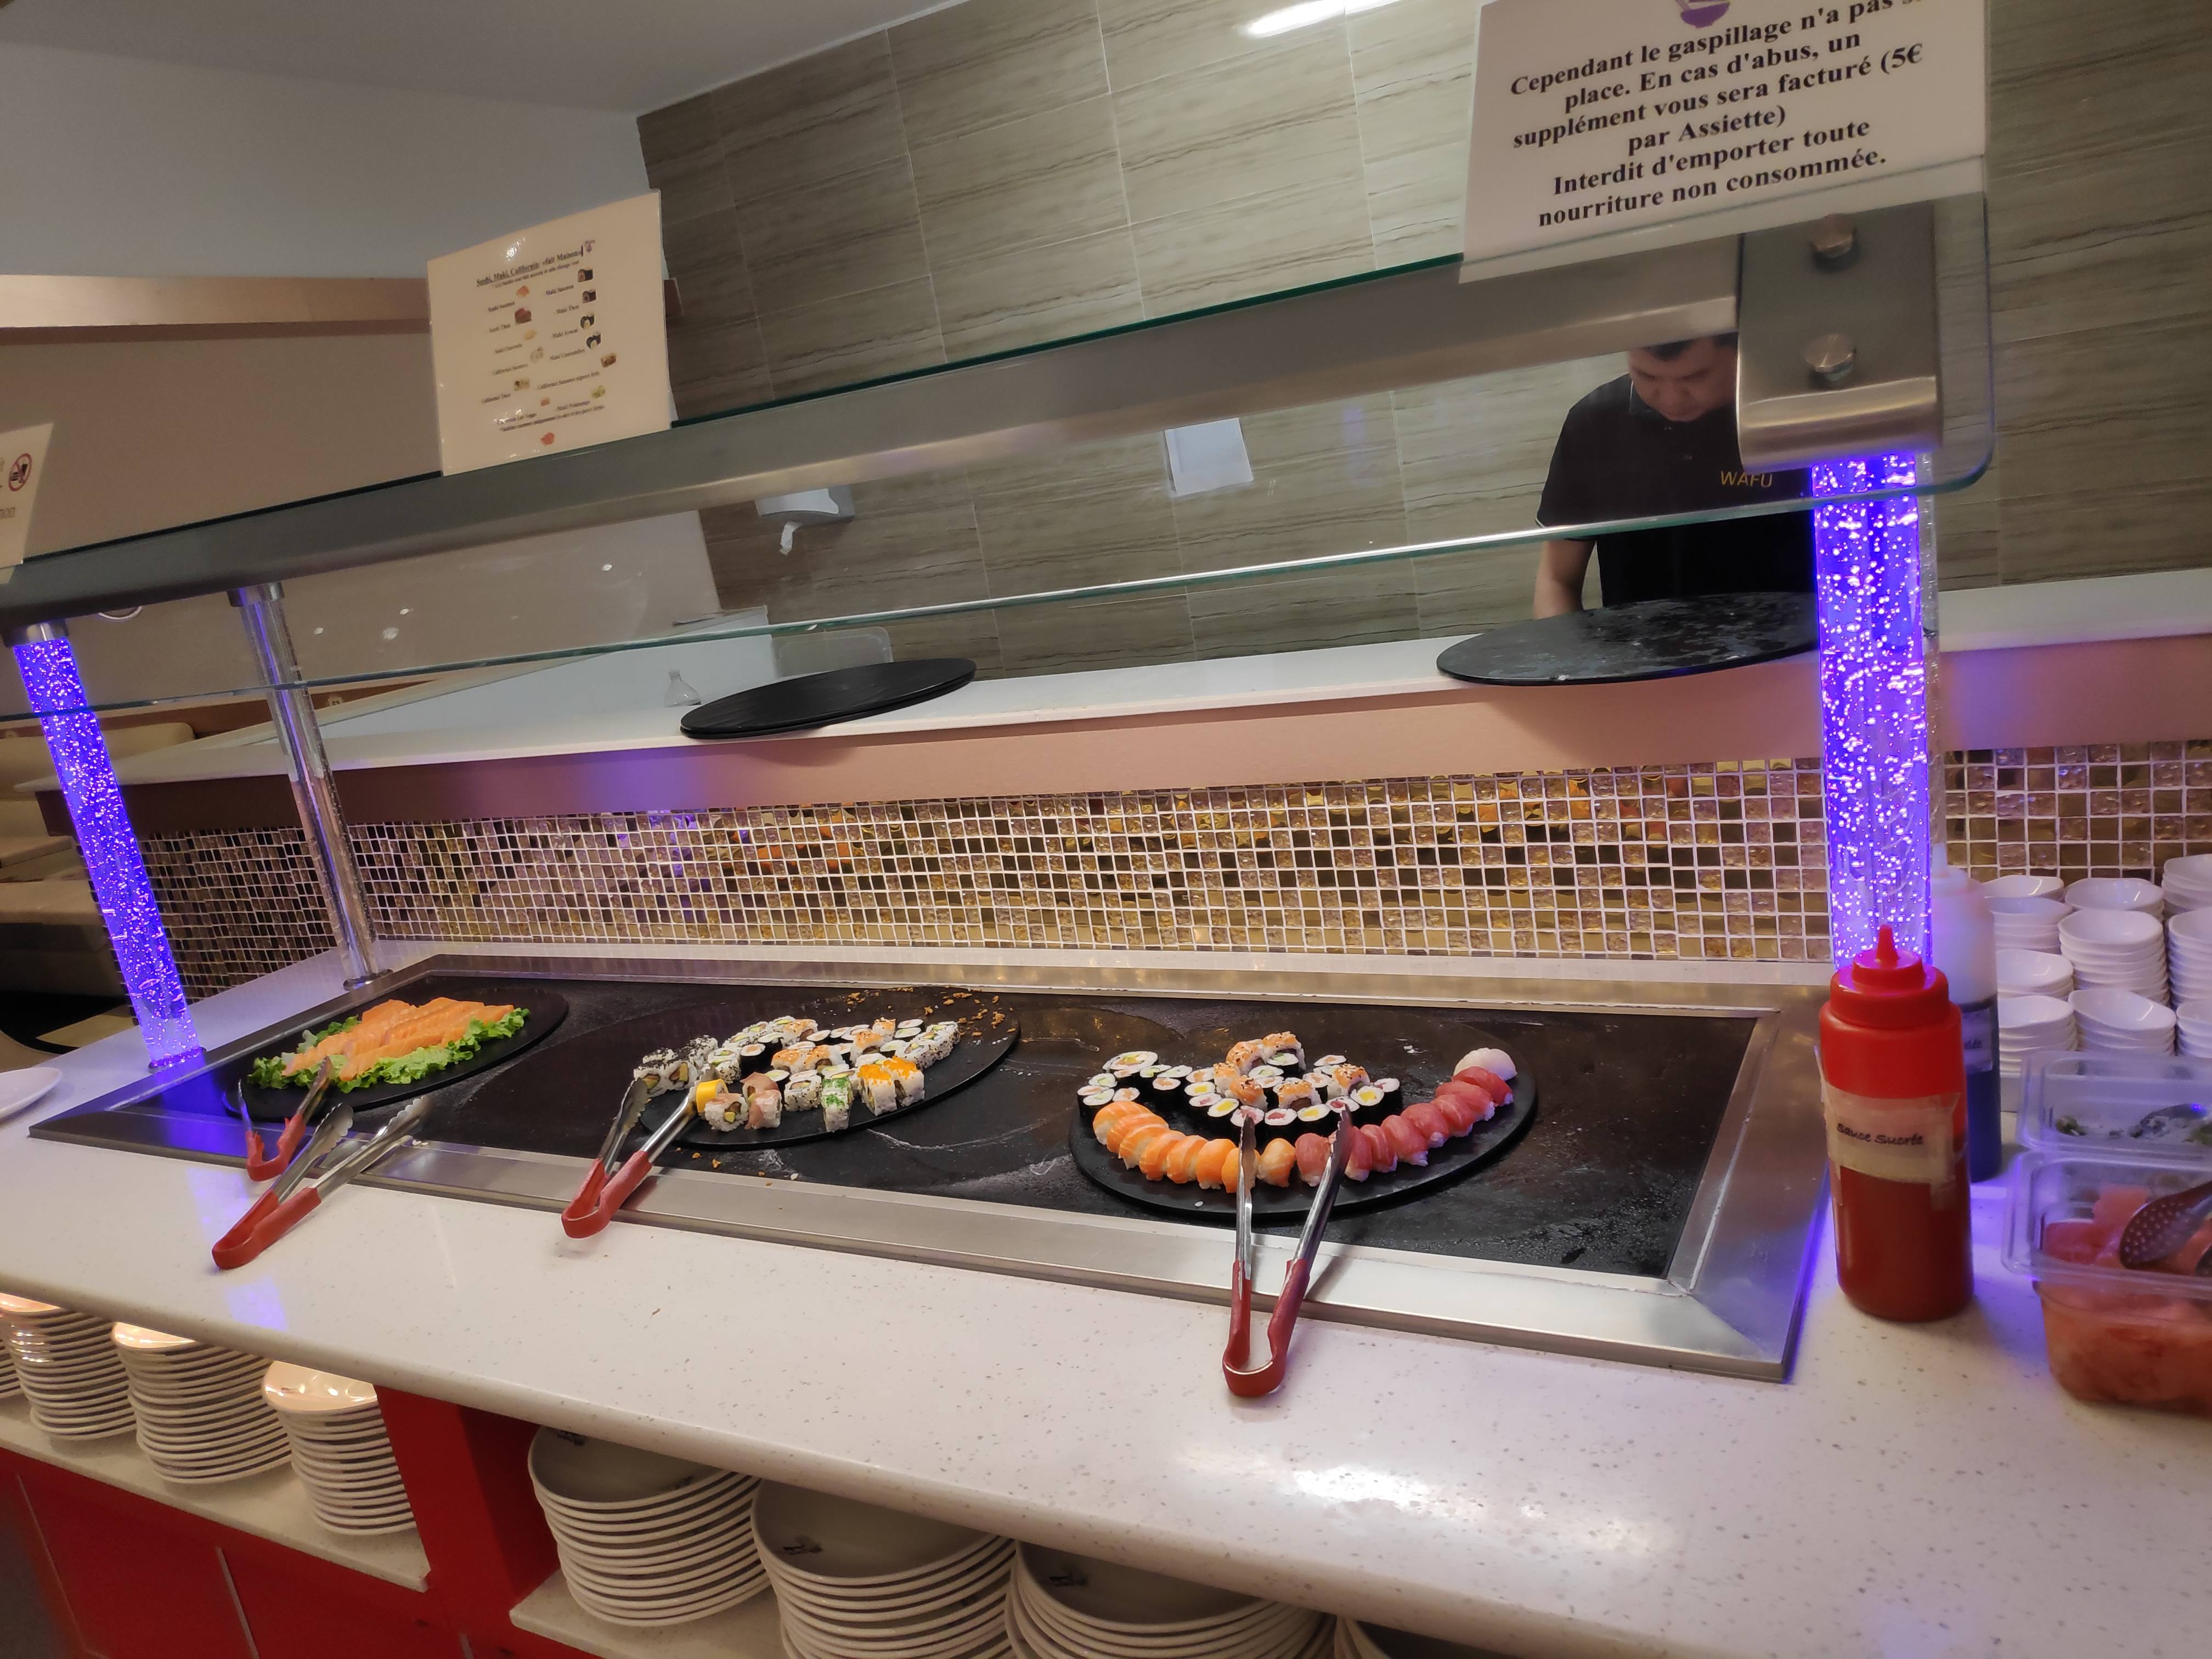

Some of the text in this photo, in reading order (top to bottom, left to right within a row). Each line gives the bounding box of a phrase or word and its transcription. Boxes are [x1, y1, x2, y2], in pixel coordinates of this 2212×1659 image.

[1510, 0, 1893, 95] Cependant le gaspillage n'a pas
[1565, 33, 1860, 114] place. En cas d'abus, un
[1513, 43, 1923, 148] supplément vous sera facturé (5€
[1628, 105, 1786, 157] par Assiette)
[1538, 148, 1886, 227] nourriture non consommée.
[1554, 121, 1870, 195] Interdit d'emporter toute
[1720, 471, 1773, 488] WAFU
